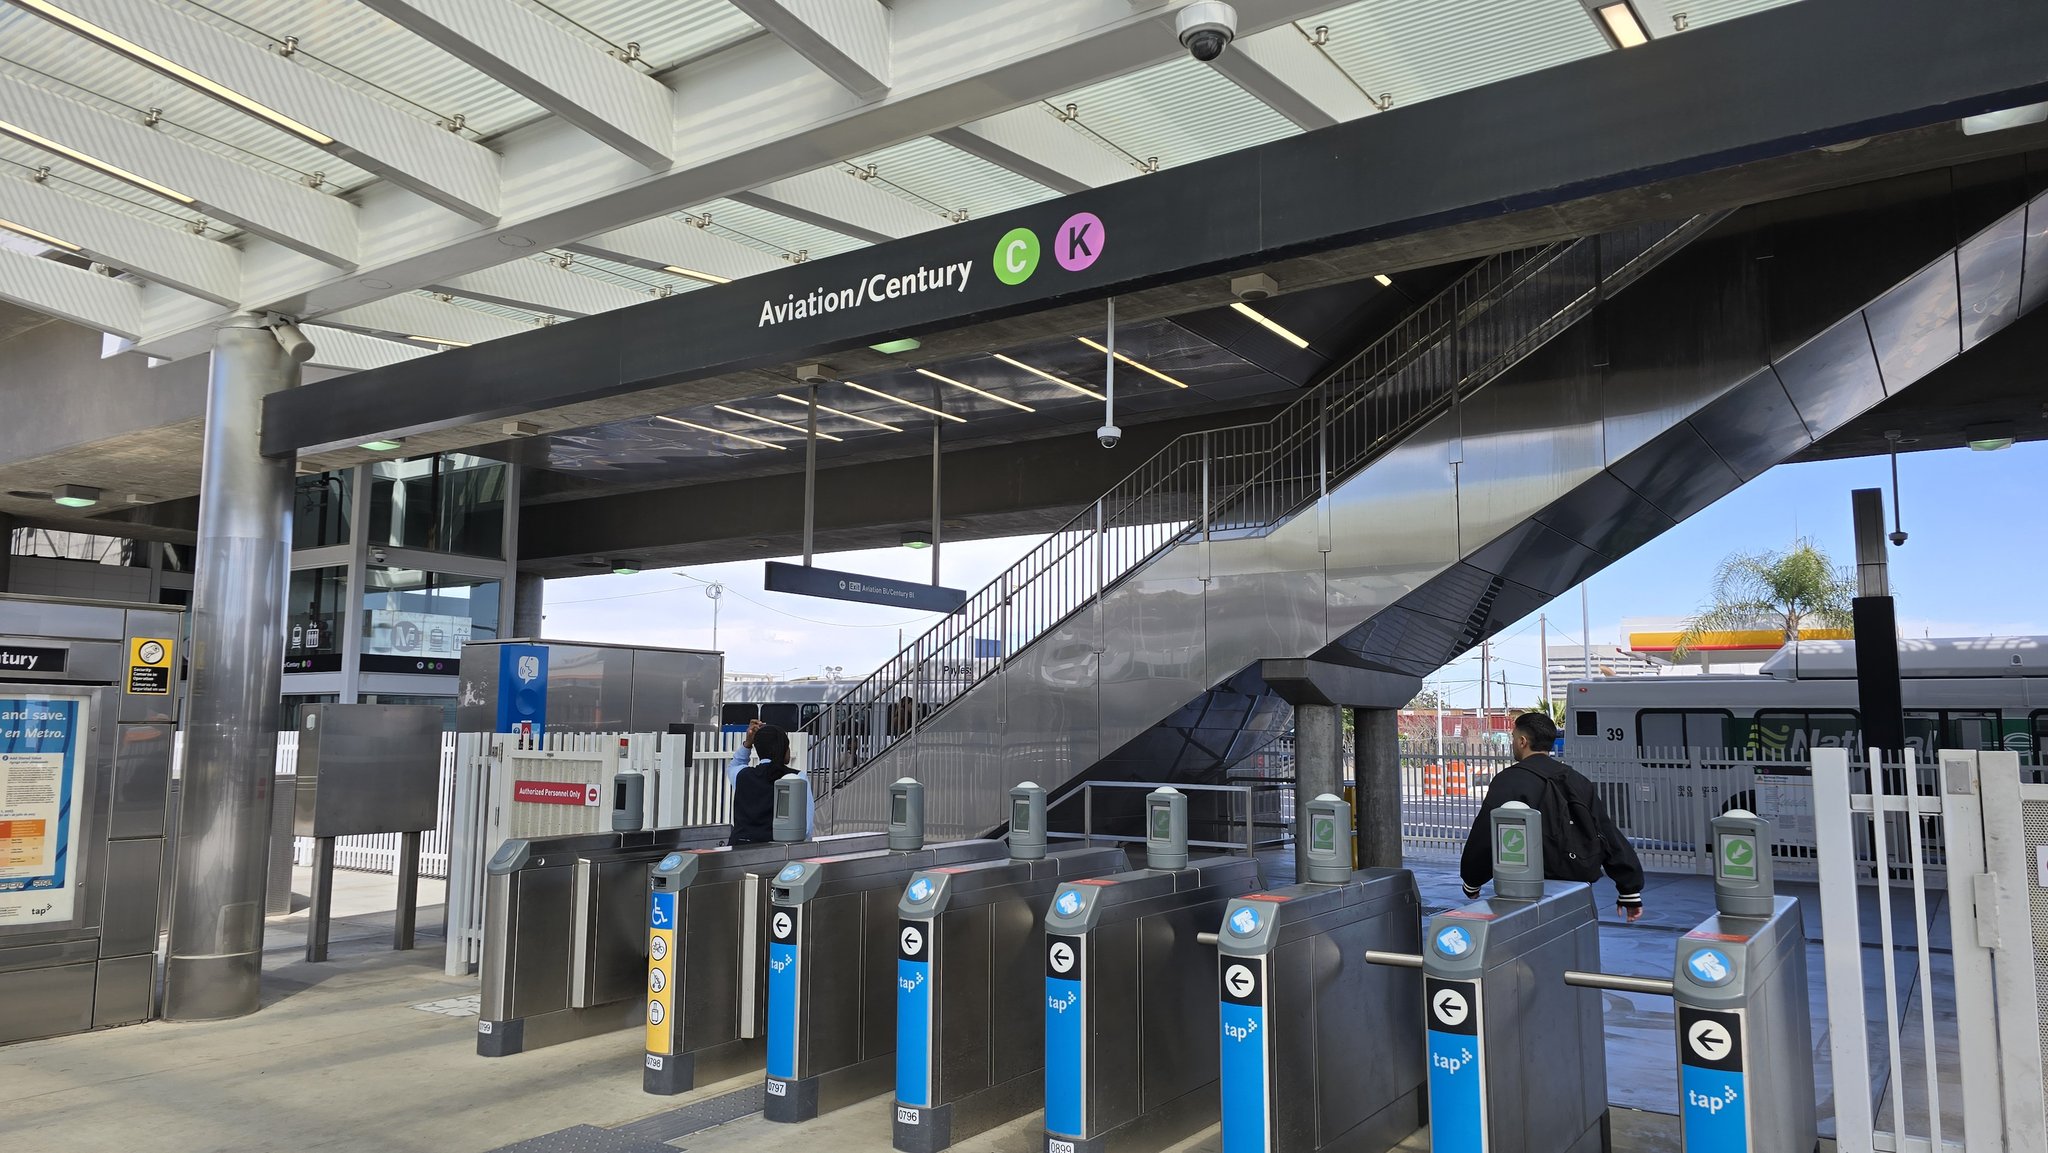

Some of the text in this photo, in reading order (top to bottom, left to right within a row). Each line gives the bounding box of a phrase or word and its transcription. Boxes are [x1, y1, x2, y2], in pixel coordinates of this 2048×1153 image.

[759, 222, 1092, 328] Aviation/Century C K
[862, 585, 882, 595] Aviation
[0, 651, 38, 669] tury
[2, 708, 66, 720] and save.
[5, 729, 20, 738] en
[24, 728, 65, 738] Metro.
[1606, 727, 1624, 741] 39
[519, 787, 581, 799] Authorized Personnel Only
[32, 907, 46, 916] tap
[771, 958, 784, 973] tap
[900, 976, 915, 992] tap
[1049, 995, 1067, 1014] tap
[1224, 1022, 1247, 1042] tap
[1433, 1052, 1460, 1075] tap
[768, 1081, 784, 1093] 0797
[1689, 1089, 1723, 1115] tap
[899, 1109, 917, 1121] 0796
[1051, 1142, 1071, 1153] 0899
